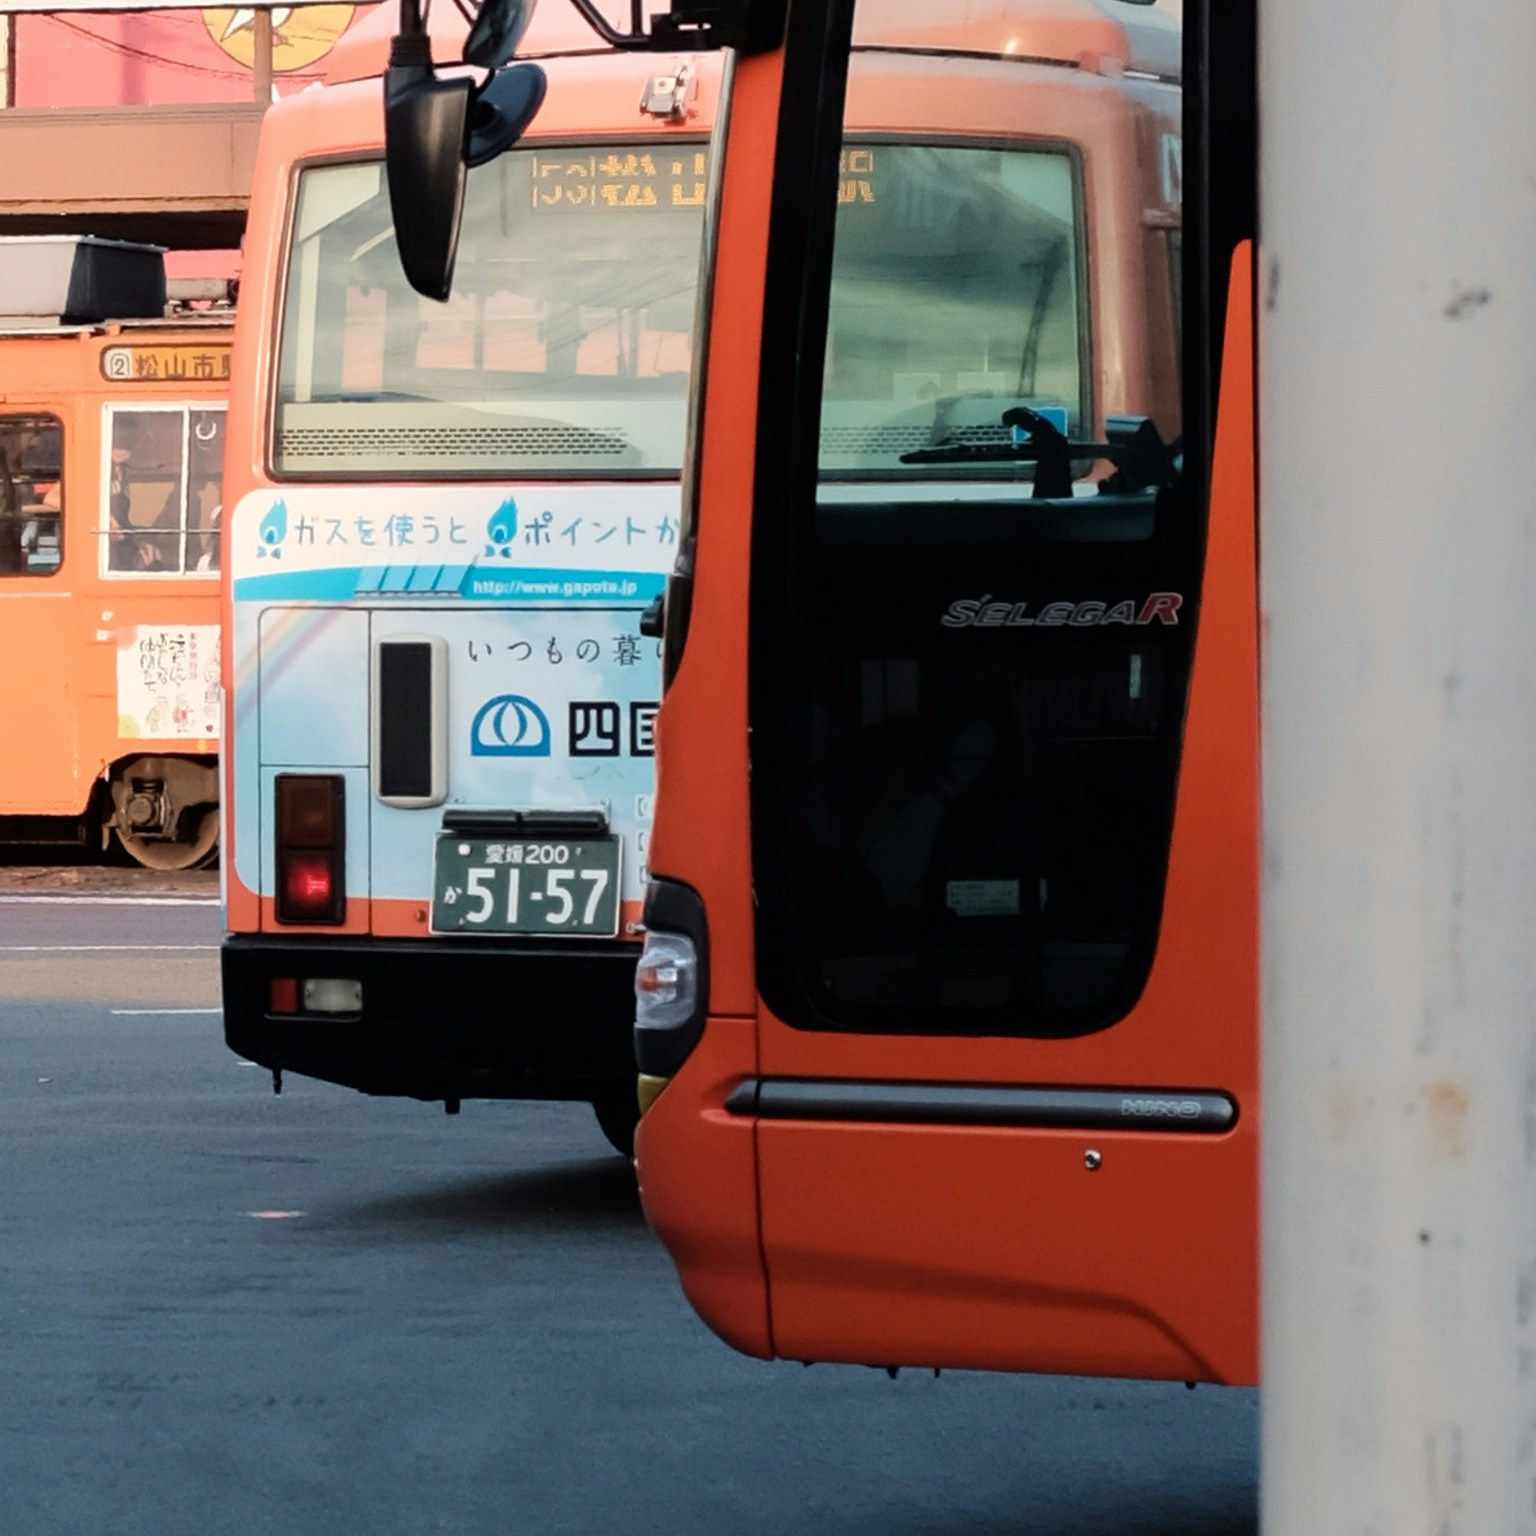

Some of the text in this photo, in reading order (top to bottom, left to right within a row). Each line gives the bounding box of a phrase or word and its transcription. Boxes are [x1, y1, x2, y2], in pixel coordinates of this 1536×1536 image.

[135, 352, 231, 378] 松山市
[294, 513, 469, 547] ガスを使うと
[465, 867, 610, 926] 51-57
